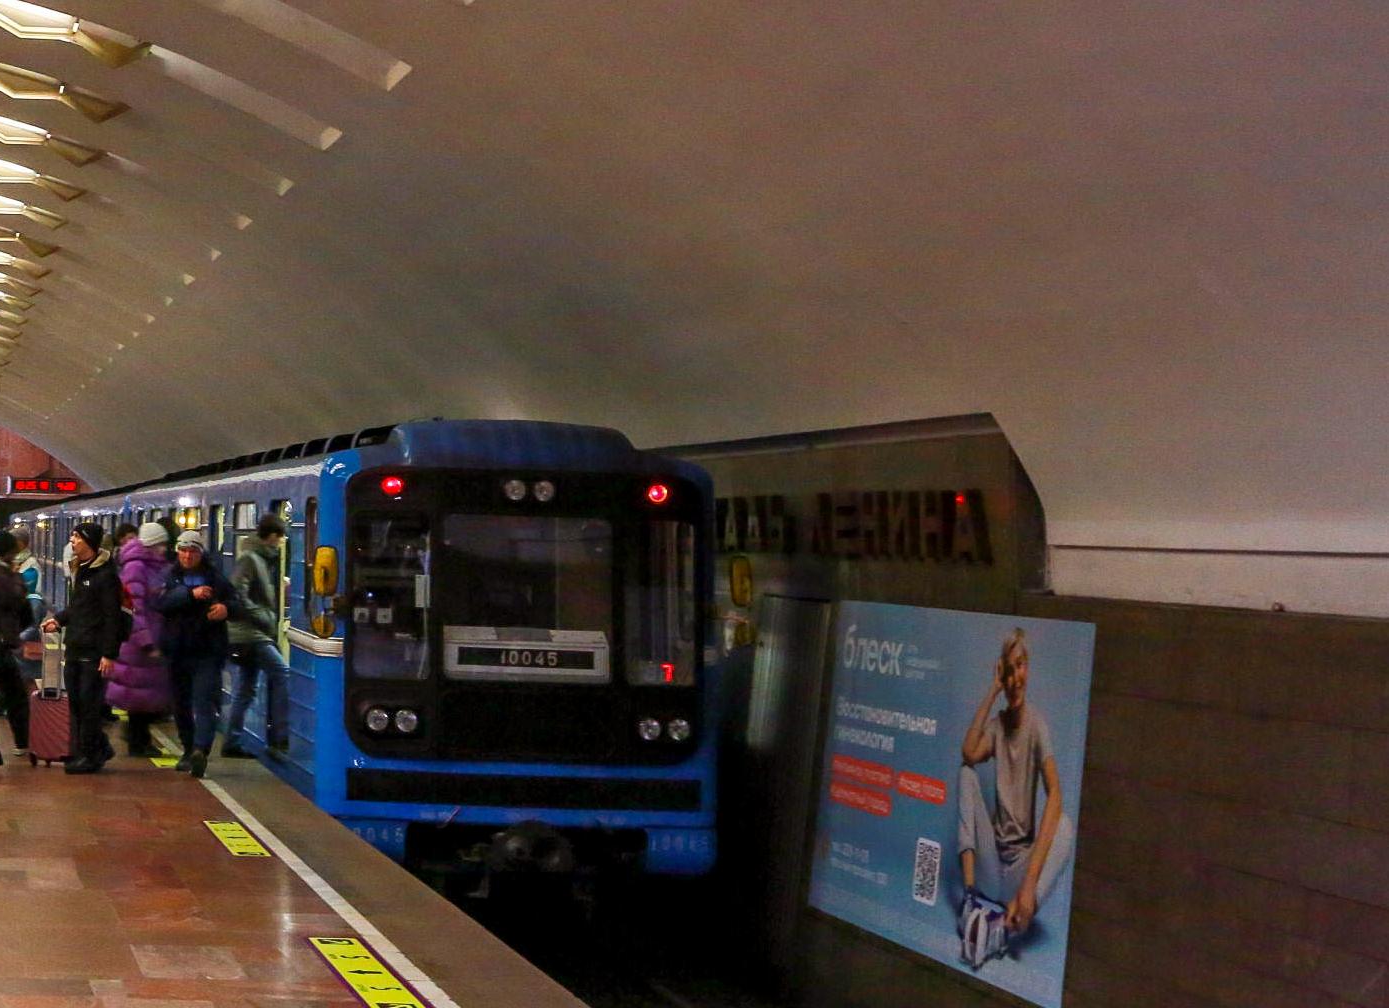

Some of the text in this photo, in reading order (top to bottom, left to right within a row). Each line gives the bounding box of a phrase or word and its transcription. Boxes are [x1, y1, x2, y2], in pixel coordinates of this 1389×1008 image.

[812, 488, 992, 566] ЛЕНИНА
[500, 650, 559, 667] 10045
[843, 624, 904, 677] блеск
